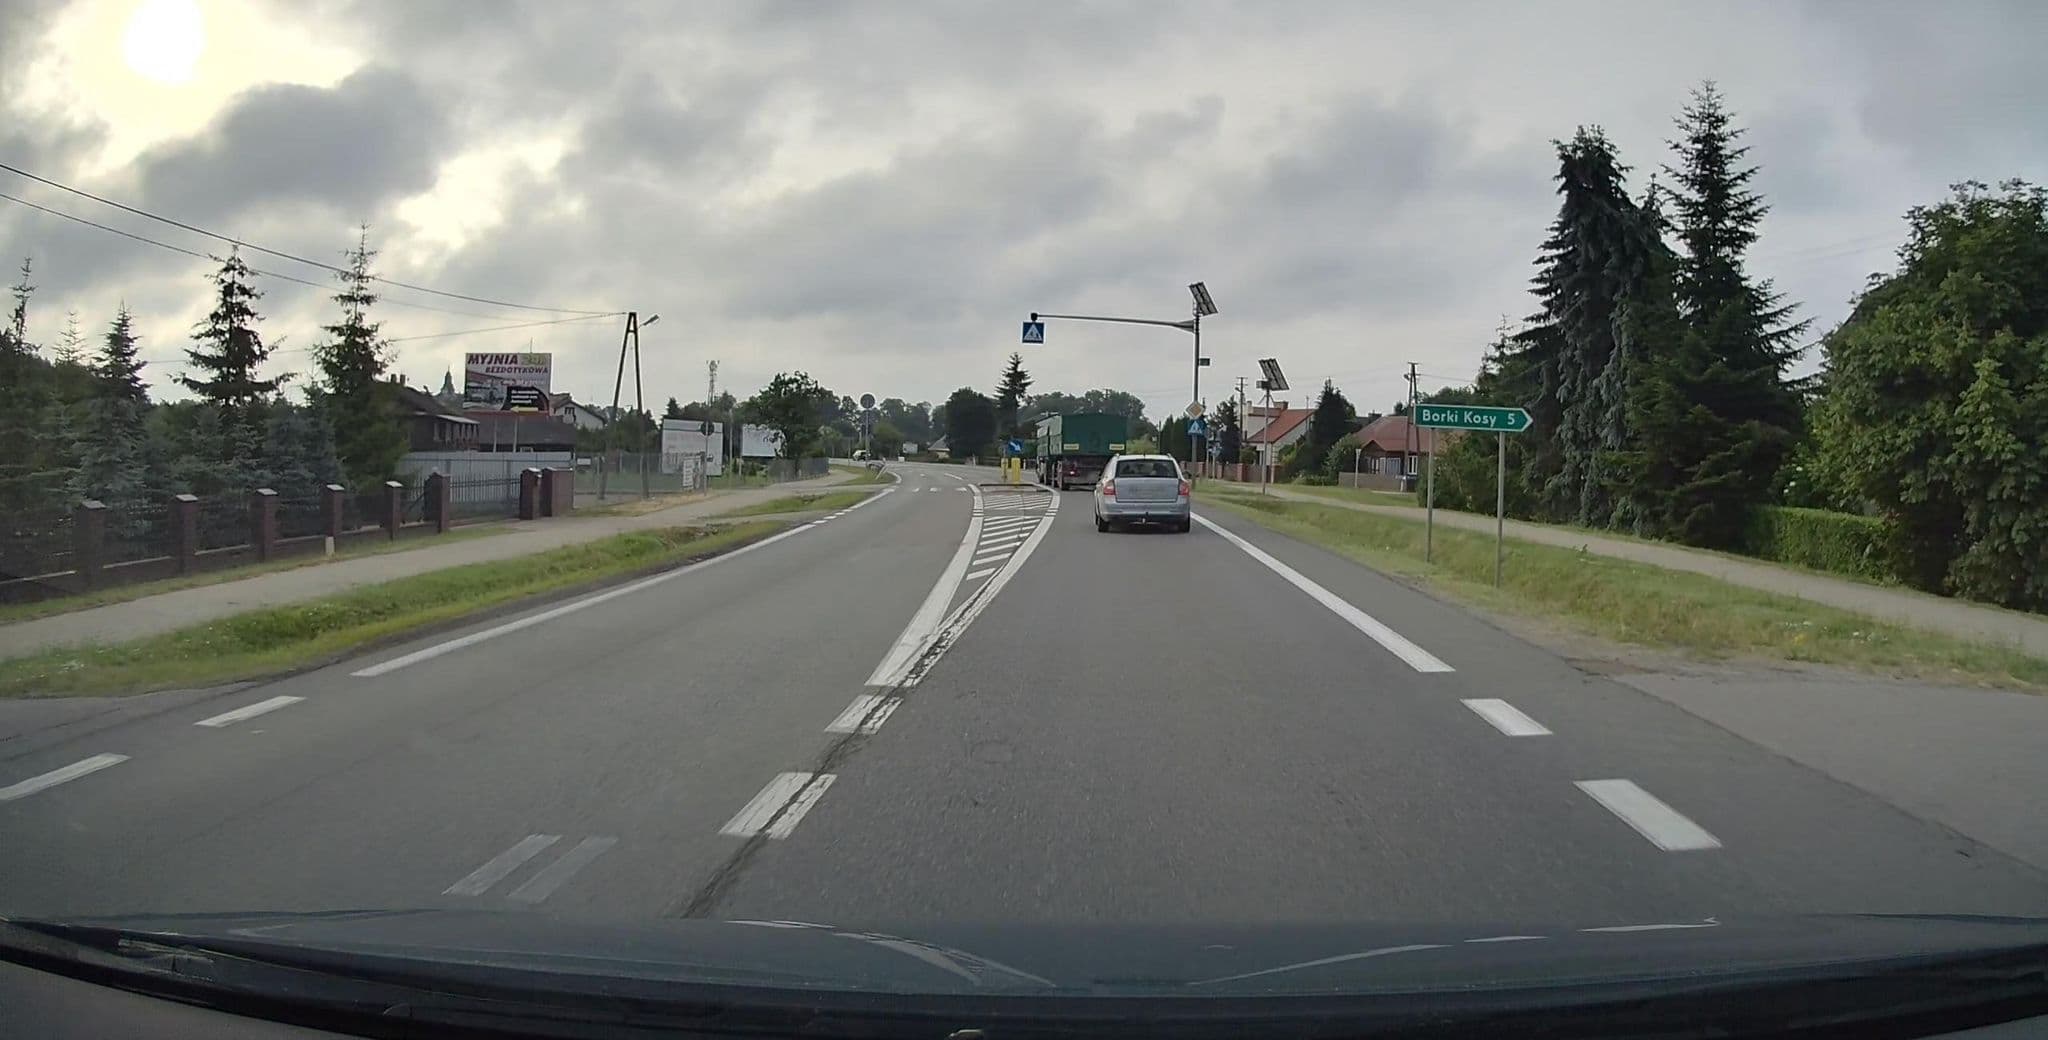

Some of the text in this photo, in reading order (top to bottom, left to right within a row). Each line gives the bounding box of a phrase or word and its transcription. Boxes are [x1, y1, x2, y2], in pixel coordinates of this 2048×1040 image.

[467, 354, 518, 365] MYJNIA
[485, 366, 548, 374] BEZDOTYKOWA
[1422, 409, 1516, 428] Borki Kosy 5
